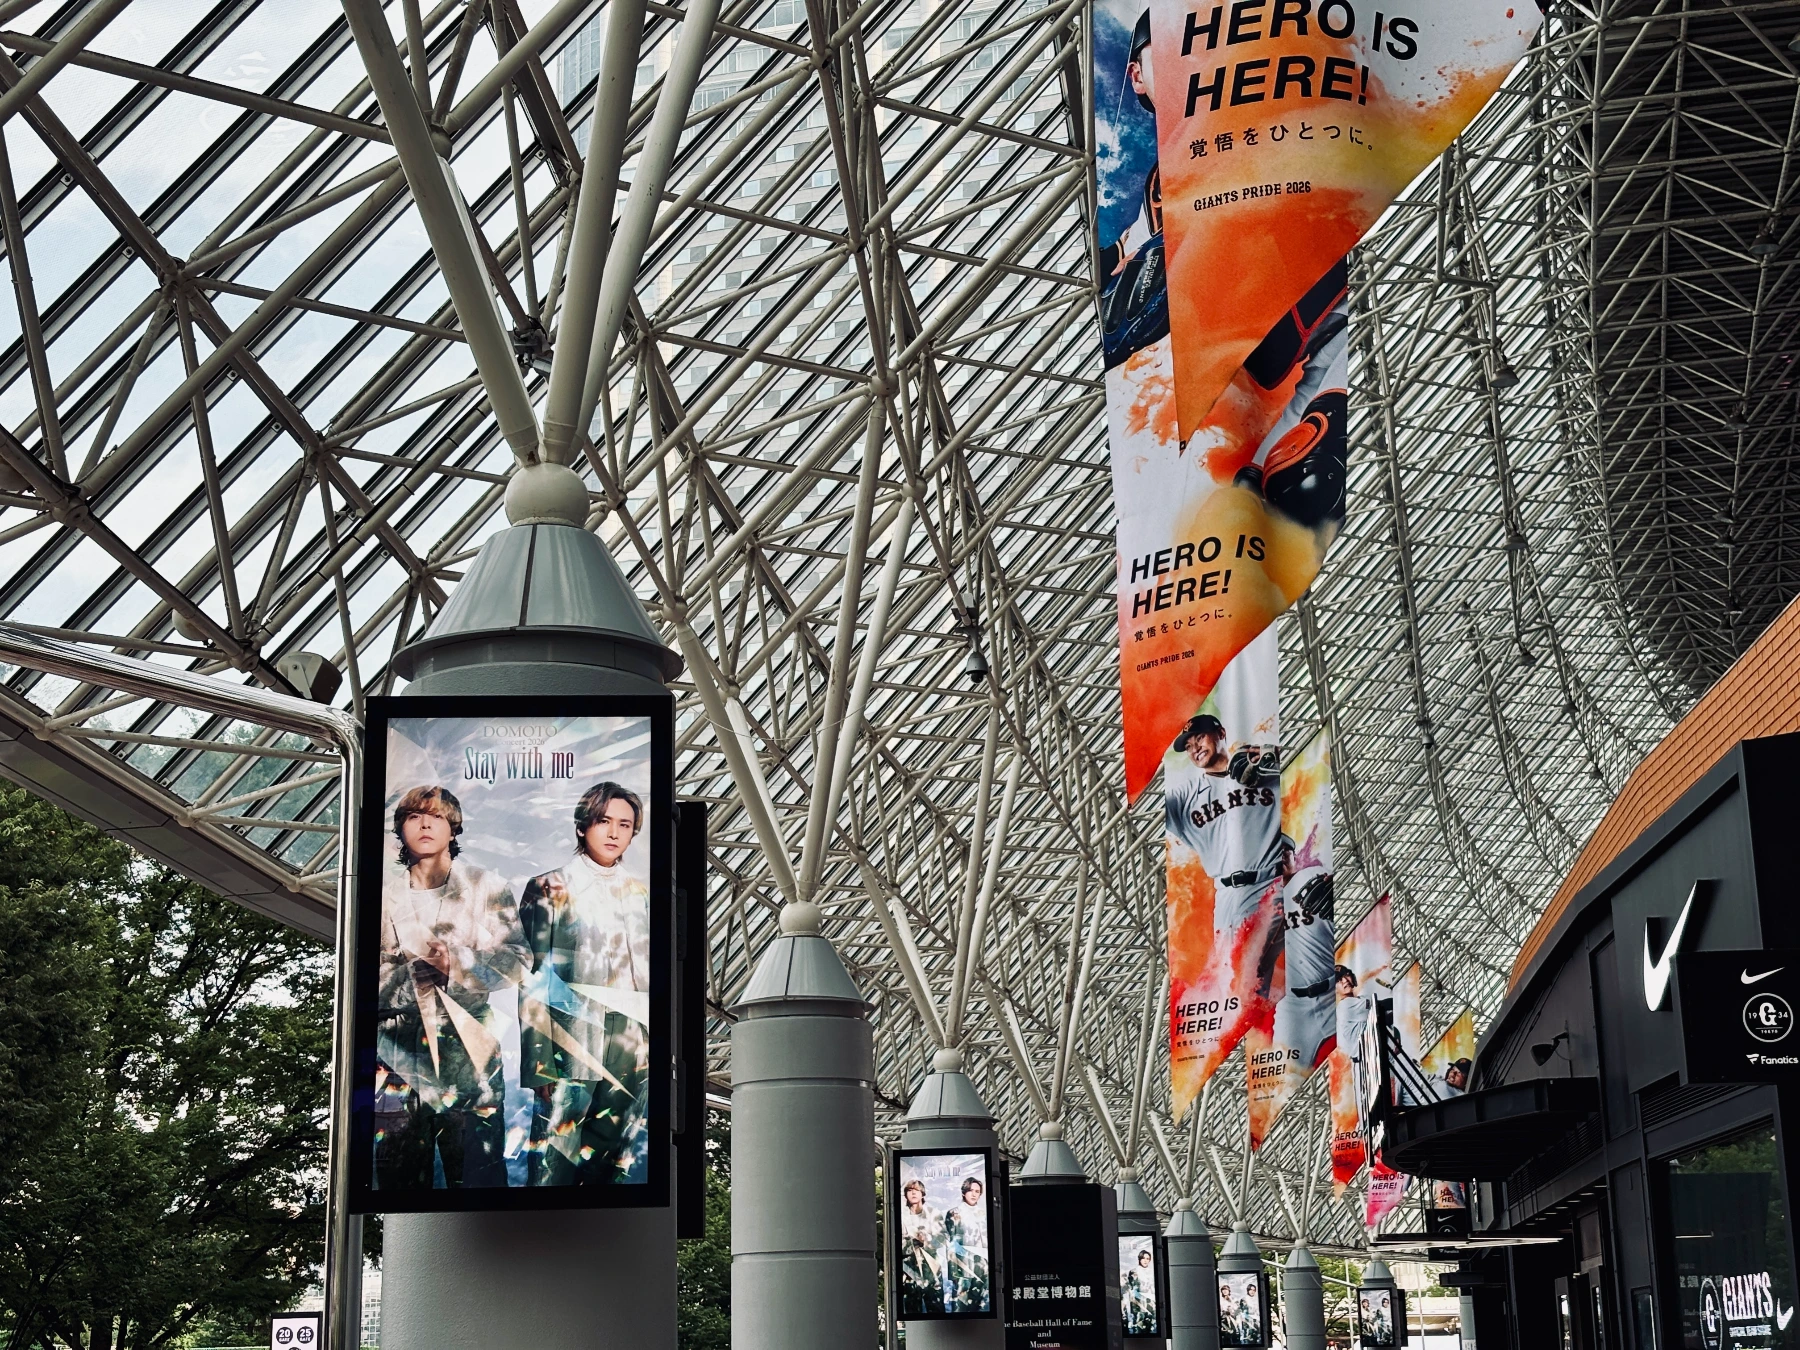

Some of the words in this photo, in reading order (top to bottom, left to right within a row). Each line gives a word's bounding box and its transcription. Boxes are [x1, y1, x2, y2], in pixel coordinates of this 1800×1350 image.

[1180, 0, 1356, 57] HERO
[1371, 11, 1420, 60] IS
[1184, 55, 1369, 118] HERE!
[1189, 121, 1373, 160] 覚悟をひとつに。
[1194, 190, 1239, 212] GIANTS
[1242, 183, 1282, 201] PRIDE
[1286, 180, 1311, 194] 2026
[1130, 536, 1222, 584] HERO
[1235, 534, 1266, 562] IS
[1132, 569, 1232, 619] HERE!
[1134, 608, 1233, 643] 覚悟をひとつに。
[1136, 659, 1159, 672] GIANTS
[1160, 653, 1180, 665] PRIDE
[484, 725, 558, 738] DOMOTO
[464, 746, 498, 784] Stay
[505, 746, 544, 780] with
[551, 751, 574, 779] me
[1191, 787, 1275, 829] GIANTS
[1175, 1000, 1219, 1018] HERO
[1224, 997, 1239, 1012] IS
[1759, 1002, 1777, 1026] G
[1778, 1011, 1789, 1019] 34
[1175, 1017, 1223, 1036] HERE!
[1251, 1051, 1283, 1066] HERO
[1287, 1049, 1300, 1060] IS
[1760, 1055, 1799, 1065] Fanatics
[1251, 1064, 1287, 1080] HERE!
[1335, 1130, 1358, 1142] HERO
[1335, 1141, 1360, 1152] HERE!
[1371, 1182, 1398, 1190] HERE!
[1372, 1173, 1396, 1182] HERO
[1722, 1271, 1774, 1321] GIANTS
[1012, 1320, 1044, 1328] Baseball
[1045, 1318, 1061, 1327] Hall
[1062, 1318, 1072, 1326] of
[1072, 1318, 1093, 1326] Fame
[278, 1328, 291, 1338] 20
[299, 1328, 312, 1337] 25
[1037, 1329, 1052, 1338] and
[1029, 1340, 1061, 1349] Museum
